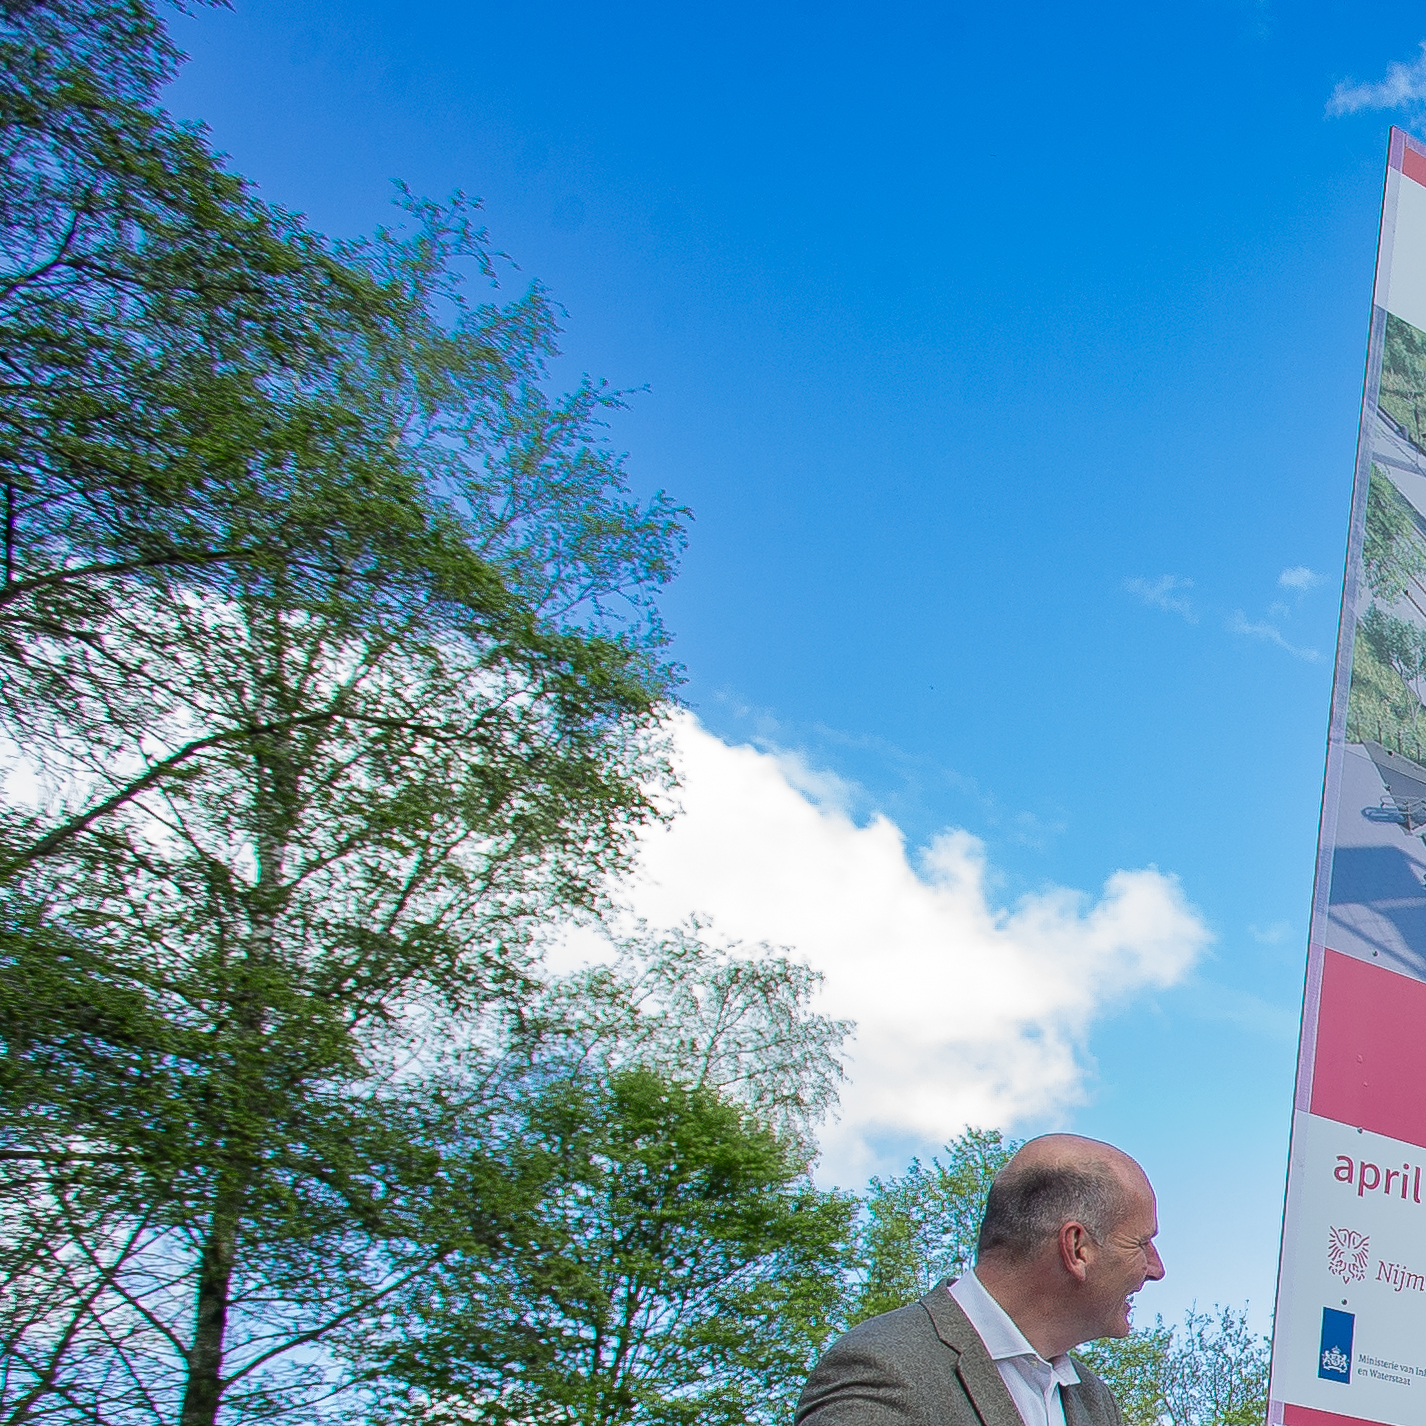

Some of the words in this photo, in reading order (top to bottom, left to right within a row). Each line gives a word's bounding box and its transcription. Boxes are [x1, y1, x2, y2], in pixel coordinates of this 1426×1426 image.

[1333, 1154, 1421, 1204] april
[1358, 1353, 1399, 1371] Ministerie
[1400, 1364, 1414, 1375] van
[1357, 1367, 1368, 1377] en
[1369, 1369, 1411, 1386] Waterstaat
